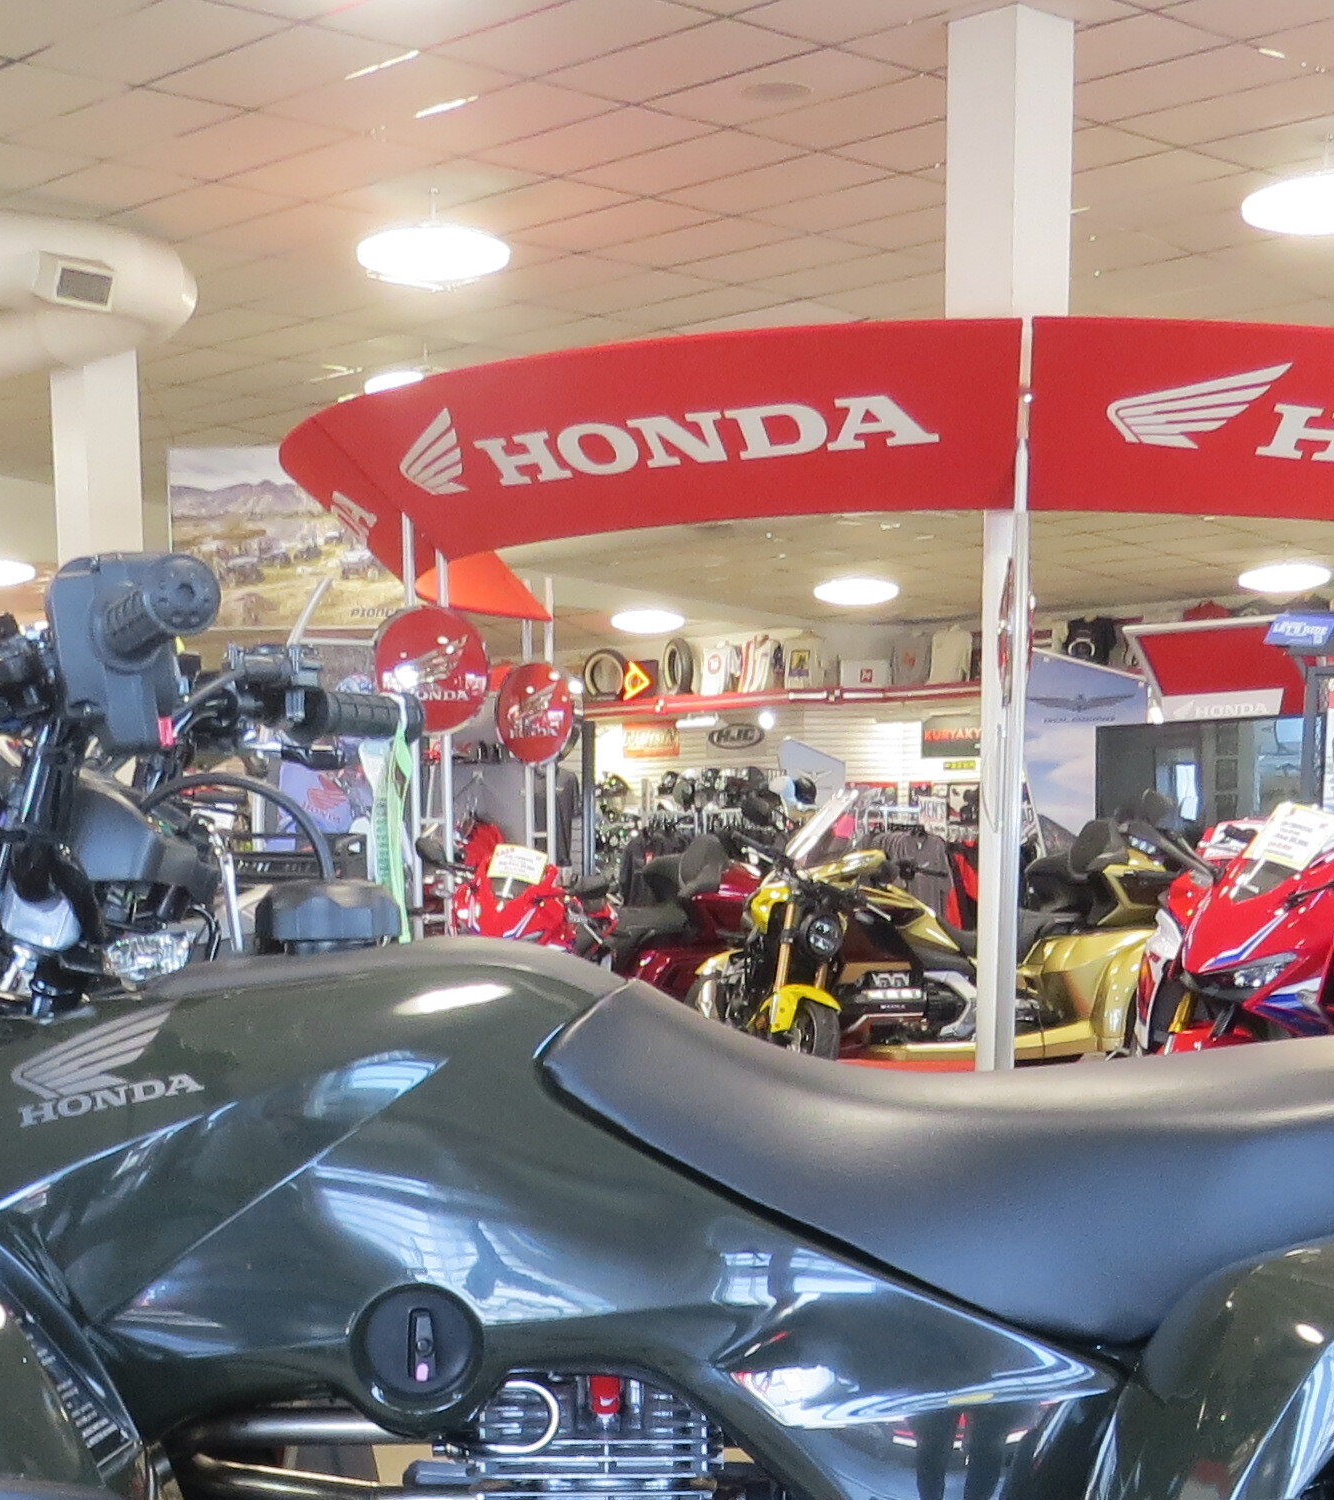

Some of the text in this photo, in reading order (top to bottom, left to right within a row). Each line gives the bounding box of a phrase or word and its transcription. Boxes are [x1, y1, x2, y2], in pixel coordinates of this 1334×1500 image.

[473, 394, 940, 487] HONDA
[415, 689, 469, 700] ONDA
[1195, 703, 1268, 718] HONDA
[718, 728, 755, 743] HJC
[923, 727, 982, 742] KURYAKY
[17, 1072, 205, 1128] HONDA
